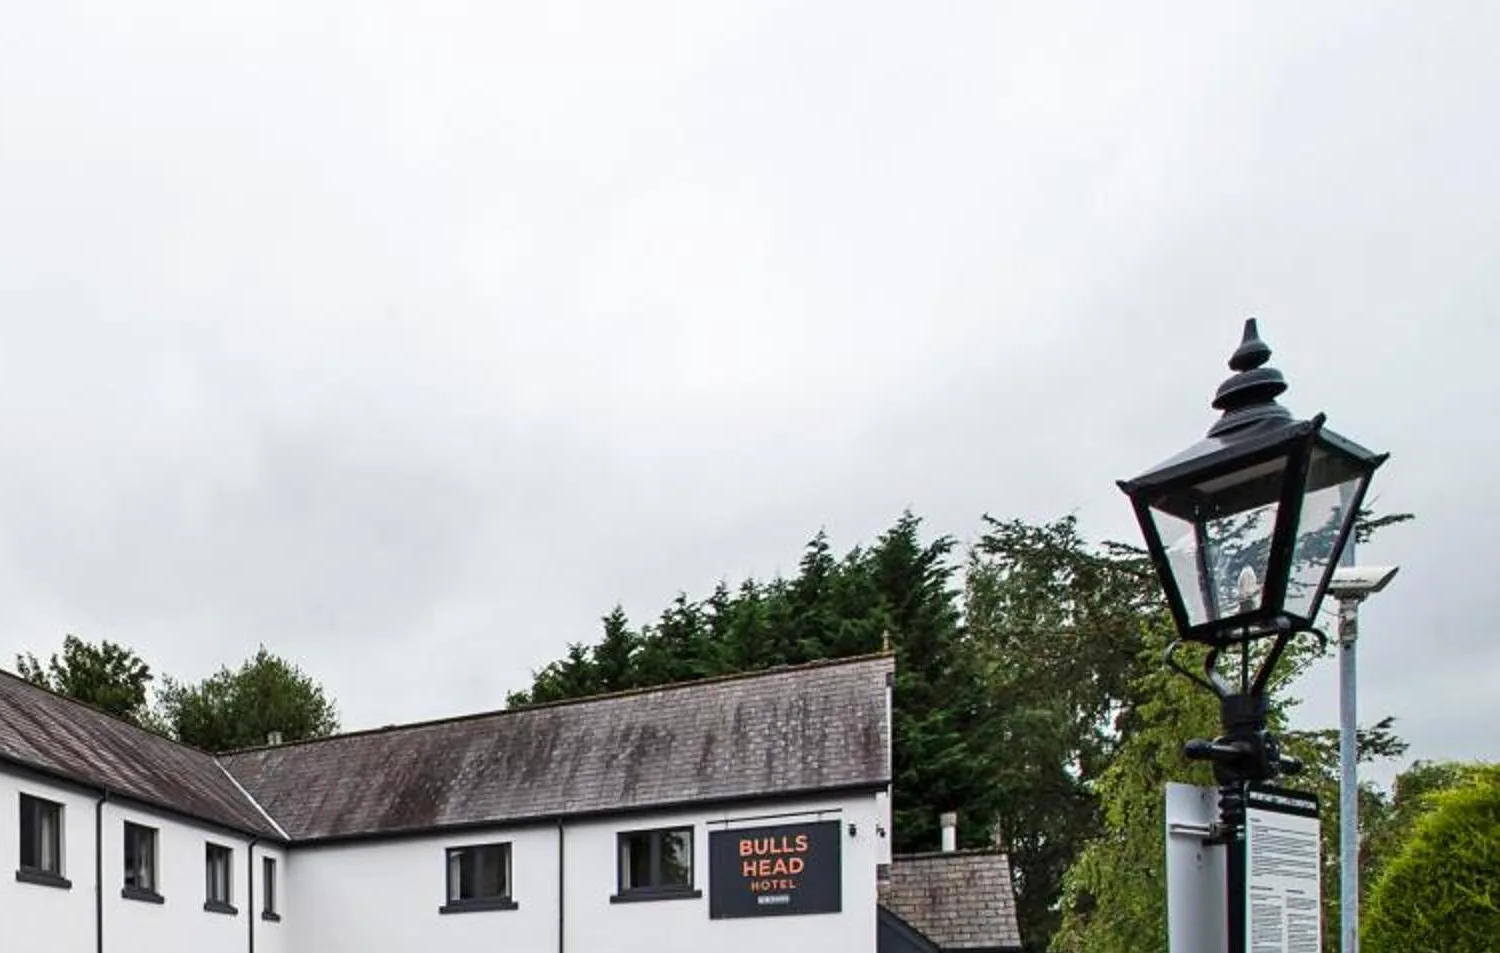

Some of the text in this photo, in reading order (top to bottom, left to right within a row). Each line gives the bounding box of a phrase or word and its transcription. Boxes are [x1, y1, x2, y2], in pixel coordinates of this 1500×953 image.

[738, 834, 809, 857] BULLS
[742, 857, 805, 877] HEAD
[750, 879, 797, 892] HOTEL
